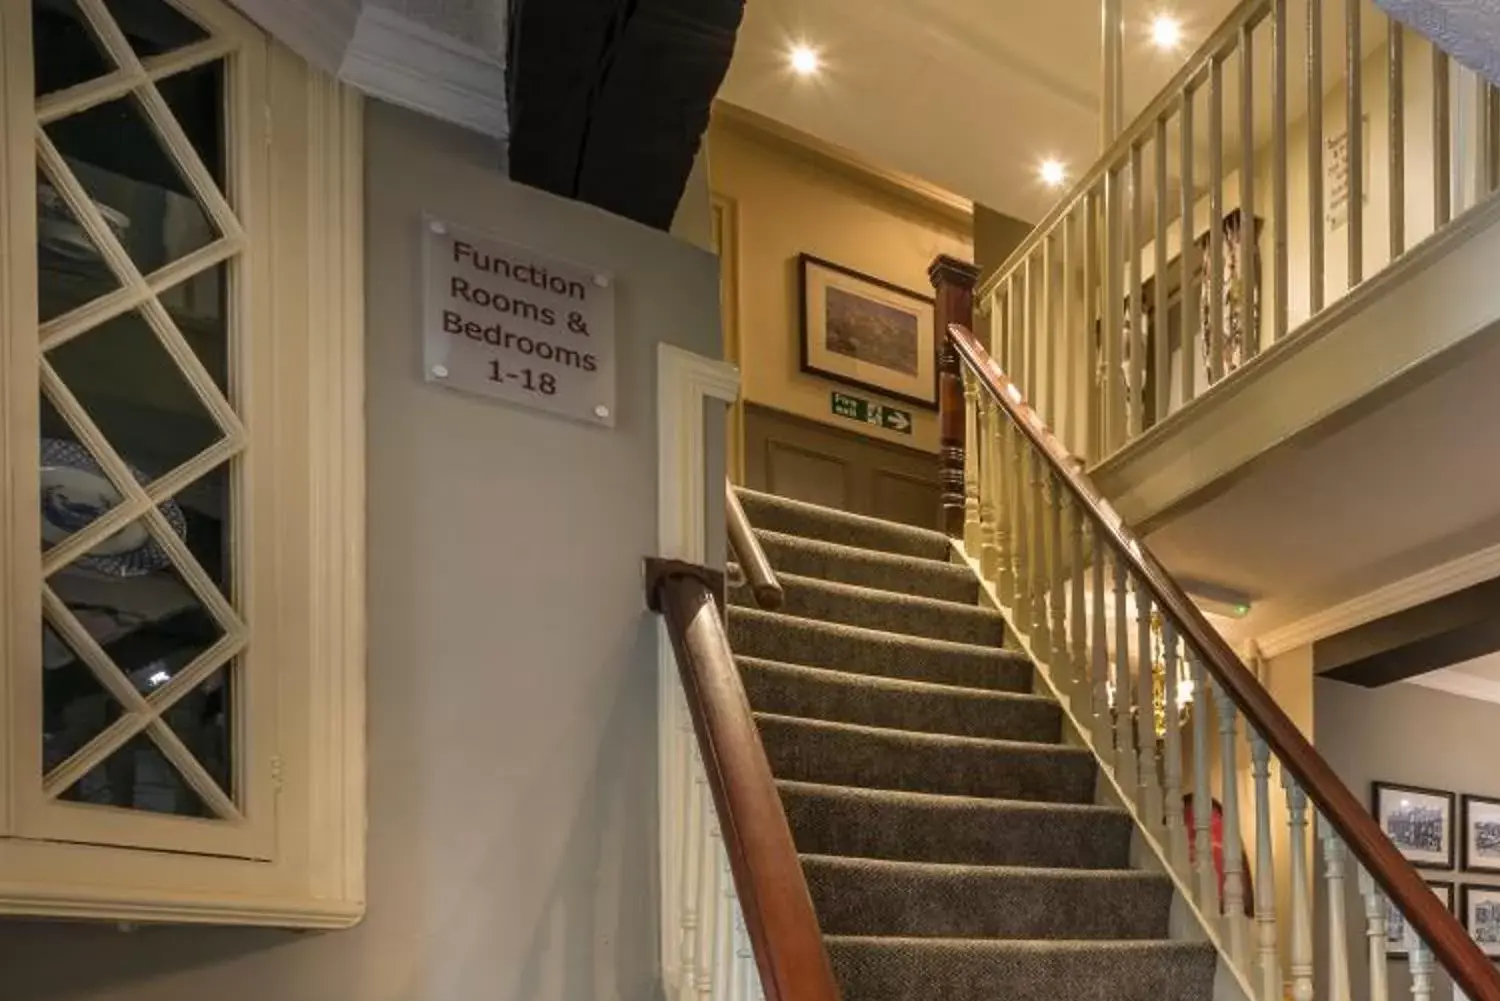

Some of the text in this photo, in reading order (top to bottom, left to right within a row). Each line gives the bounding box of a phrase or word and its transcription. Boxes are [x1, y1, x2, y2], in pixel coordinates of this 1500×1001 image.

[453, 241, 586, 300] Function
[450, 277, 590, 337] Rooms &
[443, 311, 598, 372] Bedrooms
[488, 360, 557, 395] 1-18
